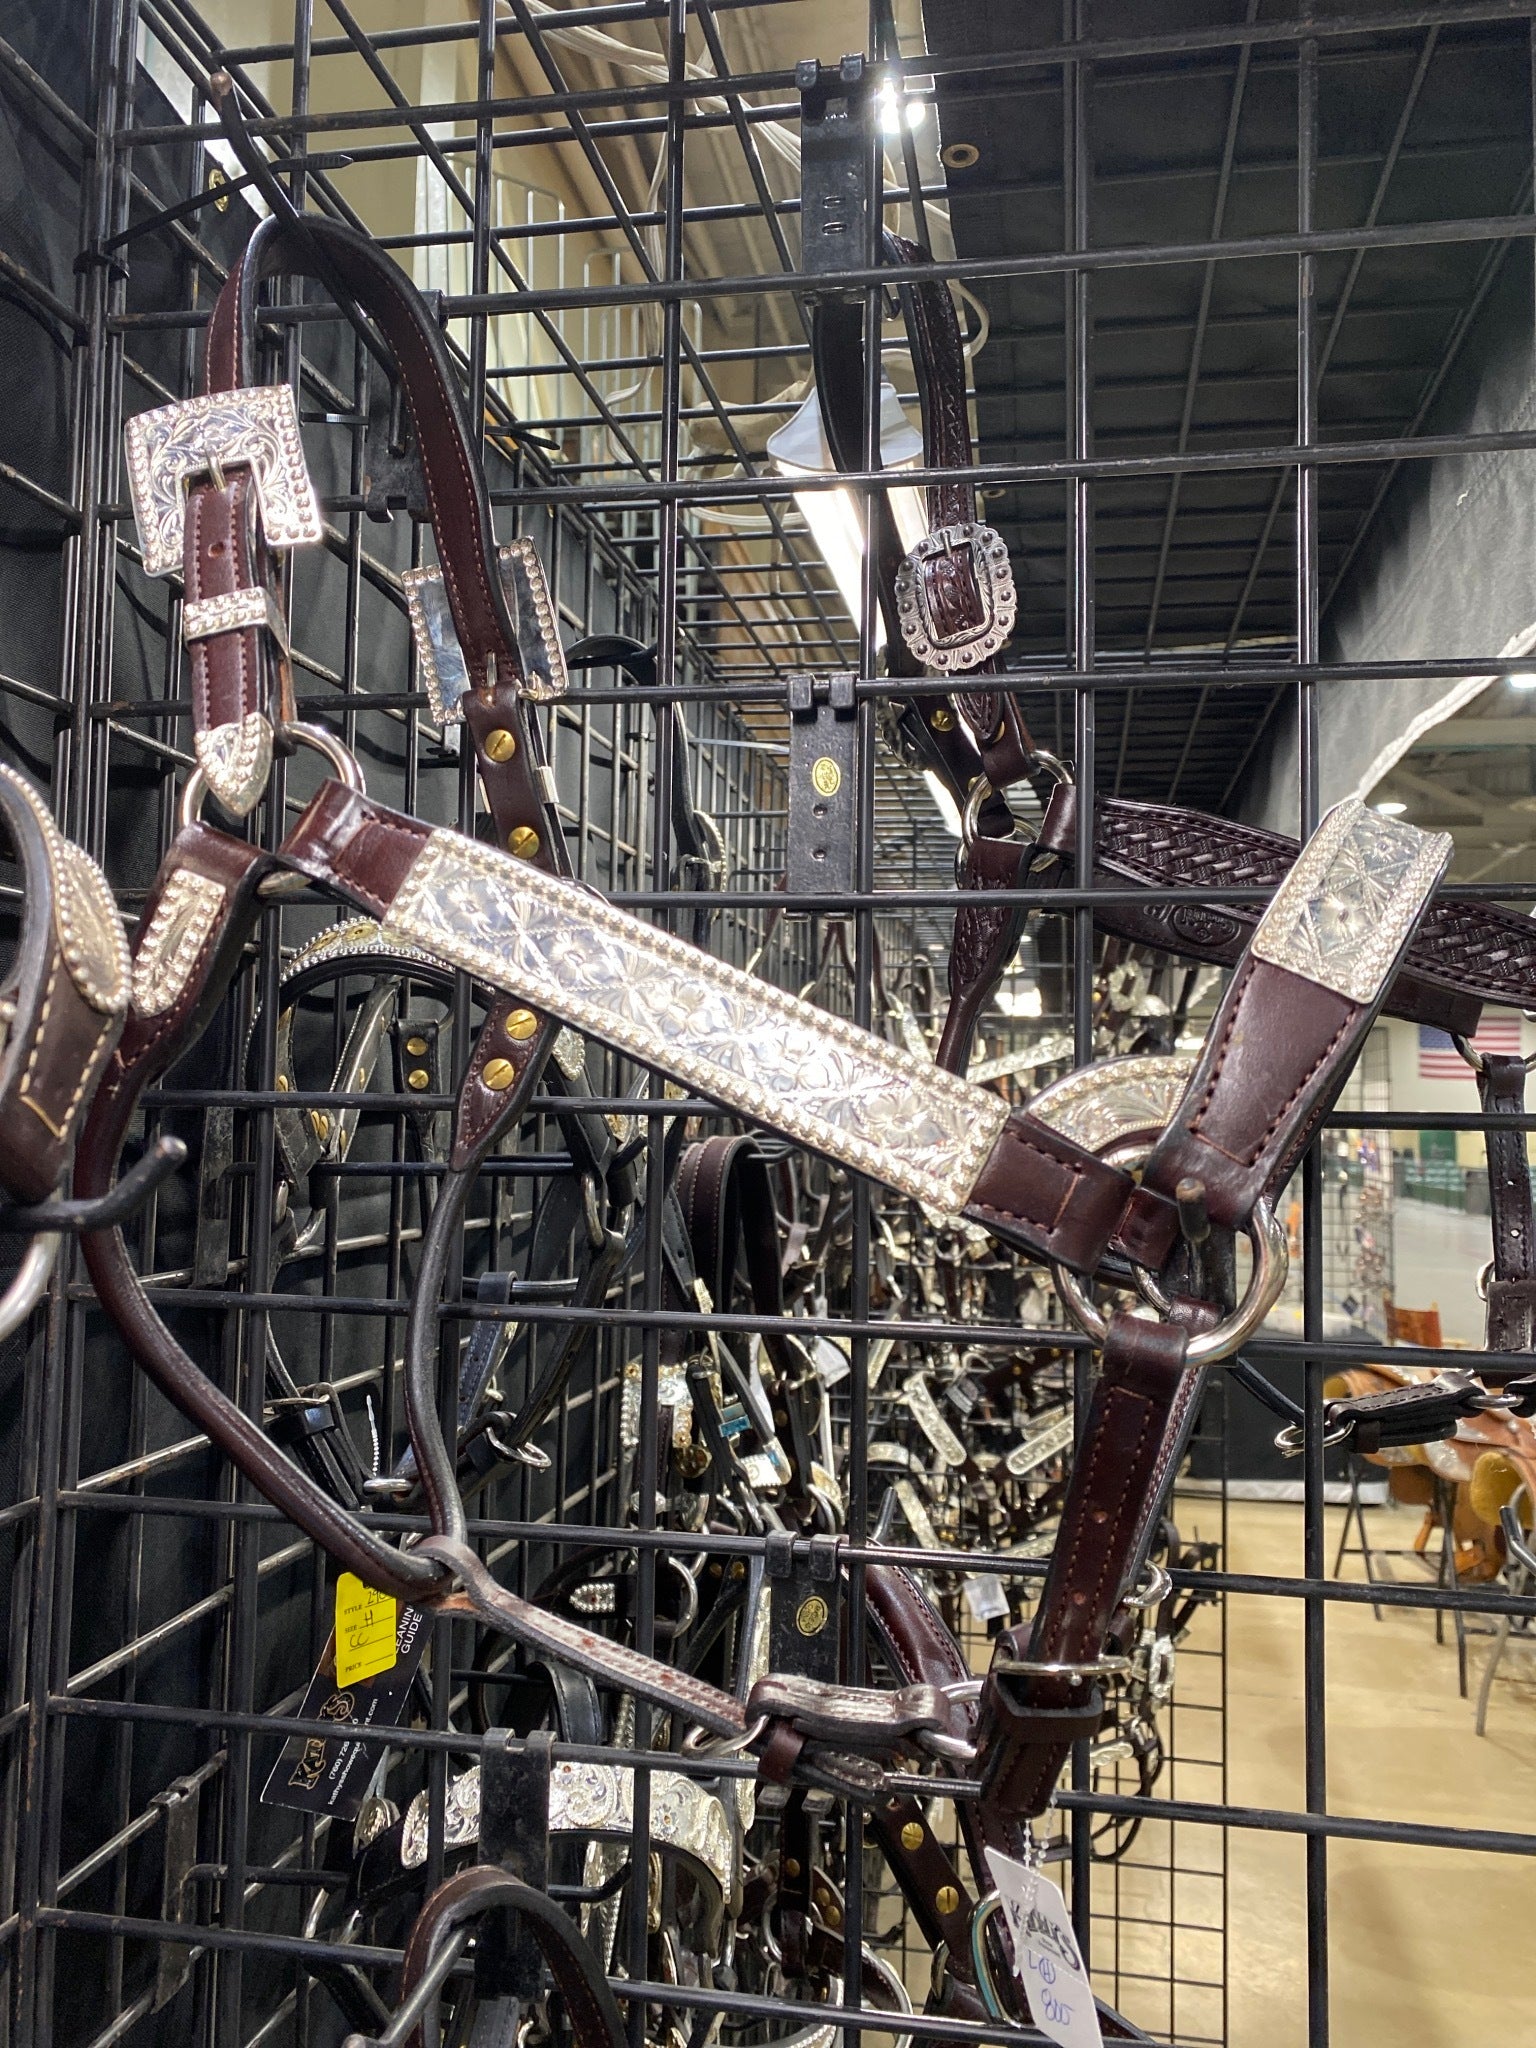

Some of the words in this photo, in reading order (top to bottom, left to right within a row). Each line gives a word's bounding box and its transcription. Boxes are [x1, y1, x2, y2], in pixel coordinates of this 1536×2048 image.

[400, 1612, 423, 1654] GUIDE
[344, 1661, 362, 1673] PRICE
[328, 1758, 344, 1780] (760)
